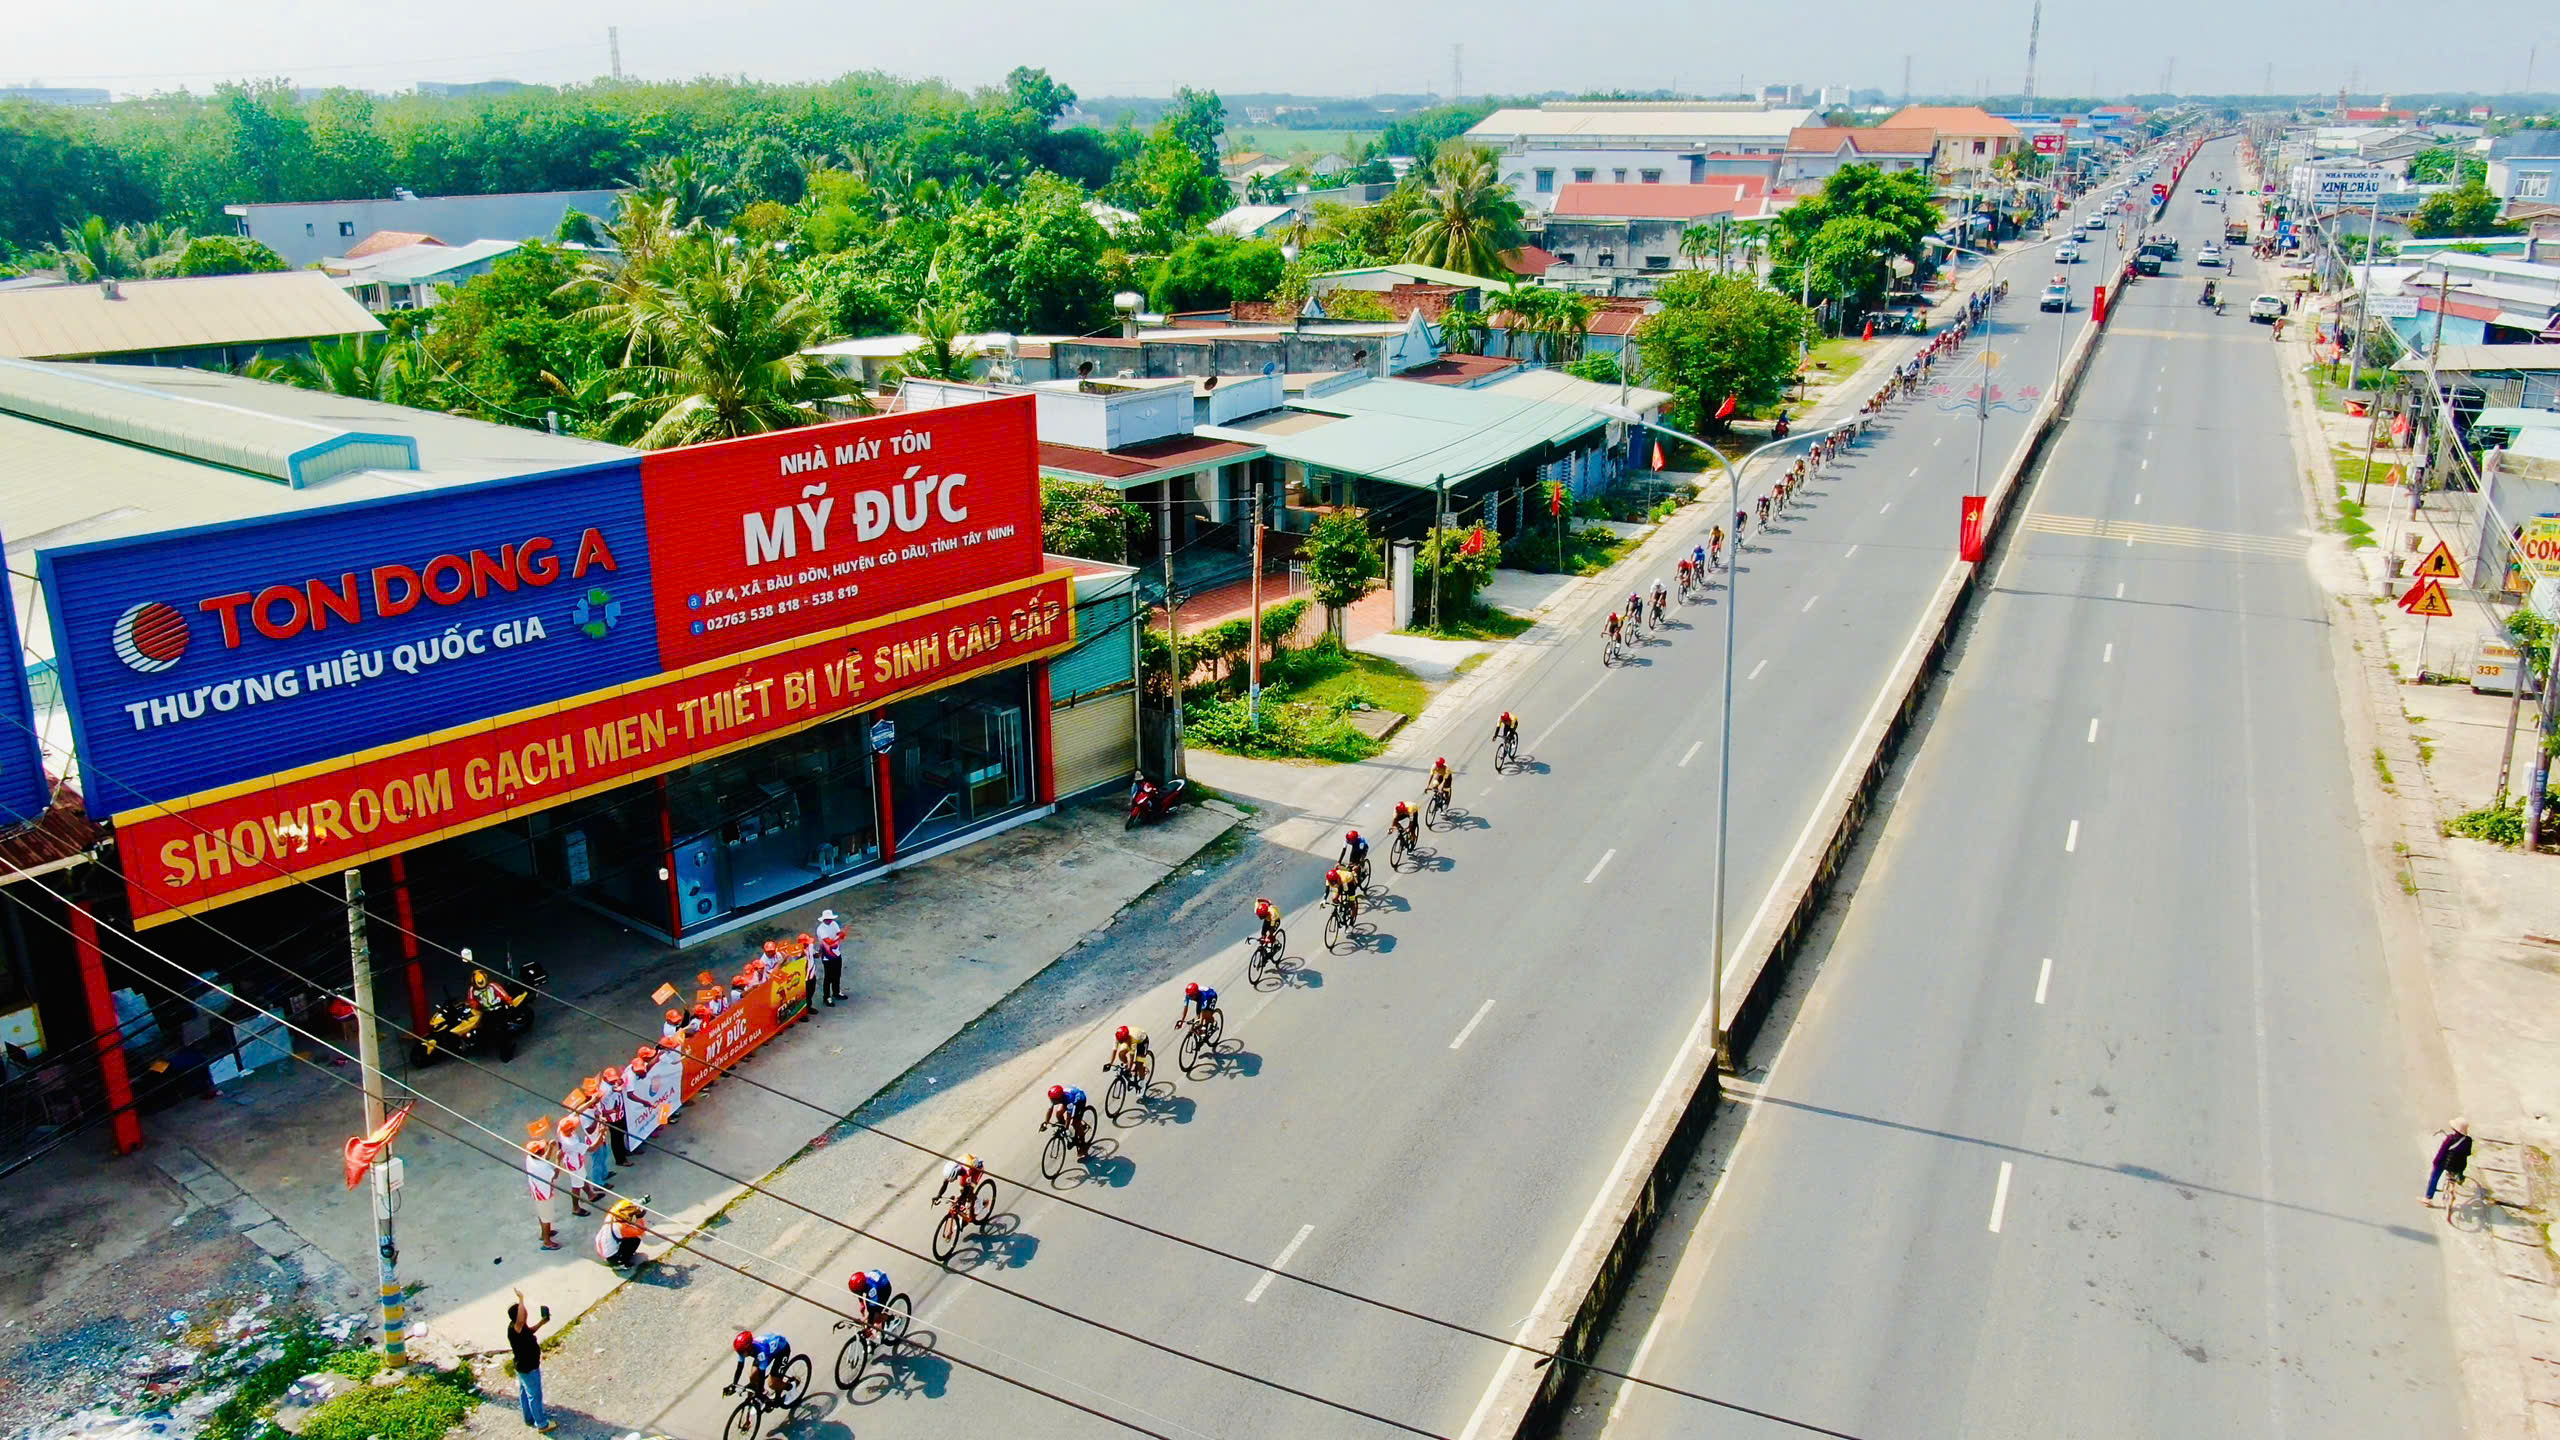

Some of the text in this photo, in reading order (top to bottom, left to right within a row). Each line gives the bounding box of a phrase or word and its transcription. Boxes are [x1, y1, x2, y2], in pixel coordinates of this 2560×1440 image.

[780, 429, 931, 476] NHÀ MÁY TÔN
[742, 465, 968, 566] MỸ ĐỨC
[199, 527, 618, 649] TON DONG A
[704, 587, 725, 607] ẤP
[726, 589, 738, 603] 4,
[741, 579, 761, 597] XÃ
[766, 573, 793, 592] BÀU
[798, 564, 831, 585] ĐỒN,
[832, 556, 875, 577] HUYỆN
[879, 548, 897, 567] GÒ
[901, 543, 930, 561] DẦU,
[930, 536, 958, 554] TỈNH
[962, 530, 982, 546] TÂY
[987, 524, 1014, 541] NINH
[706, 611, 747, 632] 02763
[749, 606, 774, 622] 538
[777, 599, 800, 614] 818
[811, 592, 834, 607] 538
[837, 584, 859, 600] 819
[125, 615, 547, 731] THƯƠNG HIỆU QUỐC GIA
[2477, 665, 2499, 676] 333
[160, 766, 455, 888] SHOWROOM
[783, 667, 817, 710] BỊ
[824, 647, 866, 698] VỆ
[874, 631, 940, 684] SINH
[946, 614, 1002, 663] CAO
[1009, 589, 1060, 644] CẤP
[705, 1018, 747, 1063] MỸ ĐỨC
